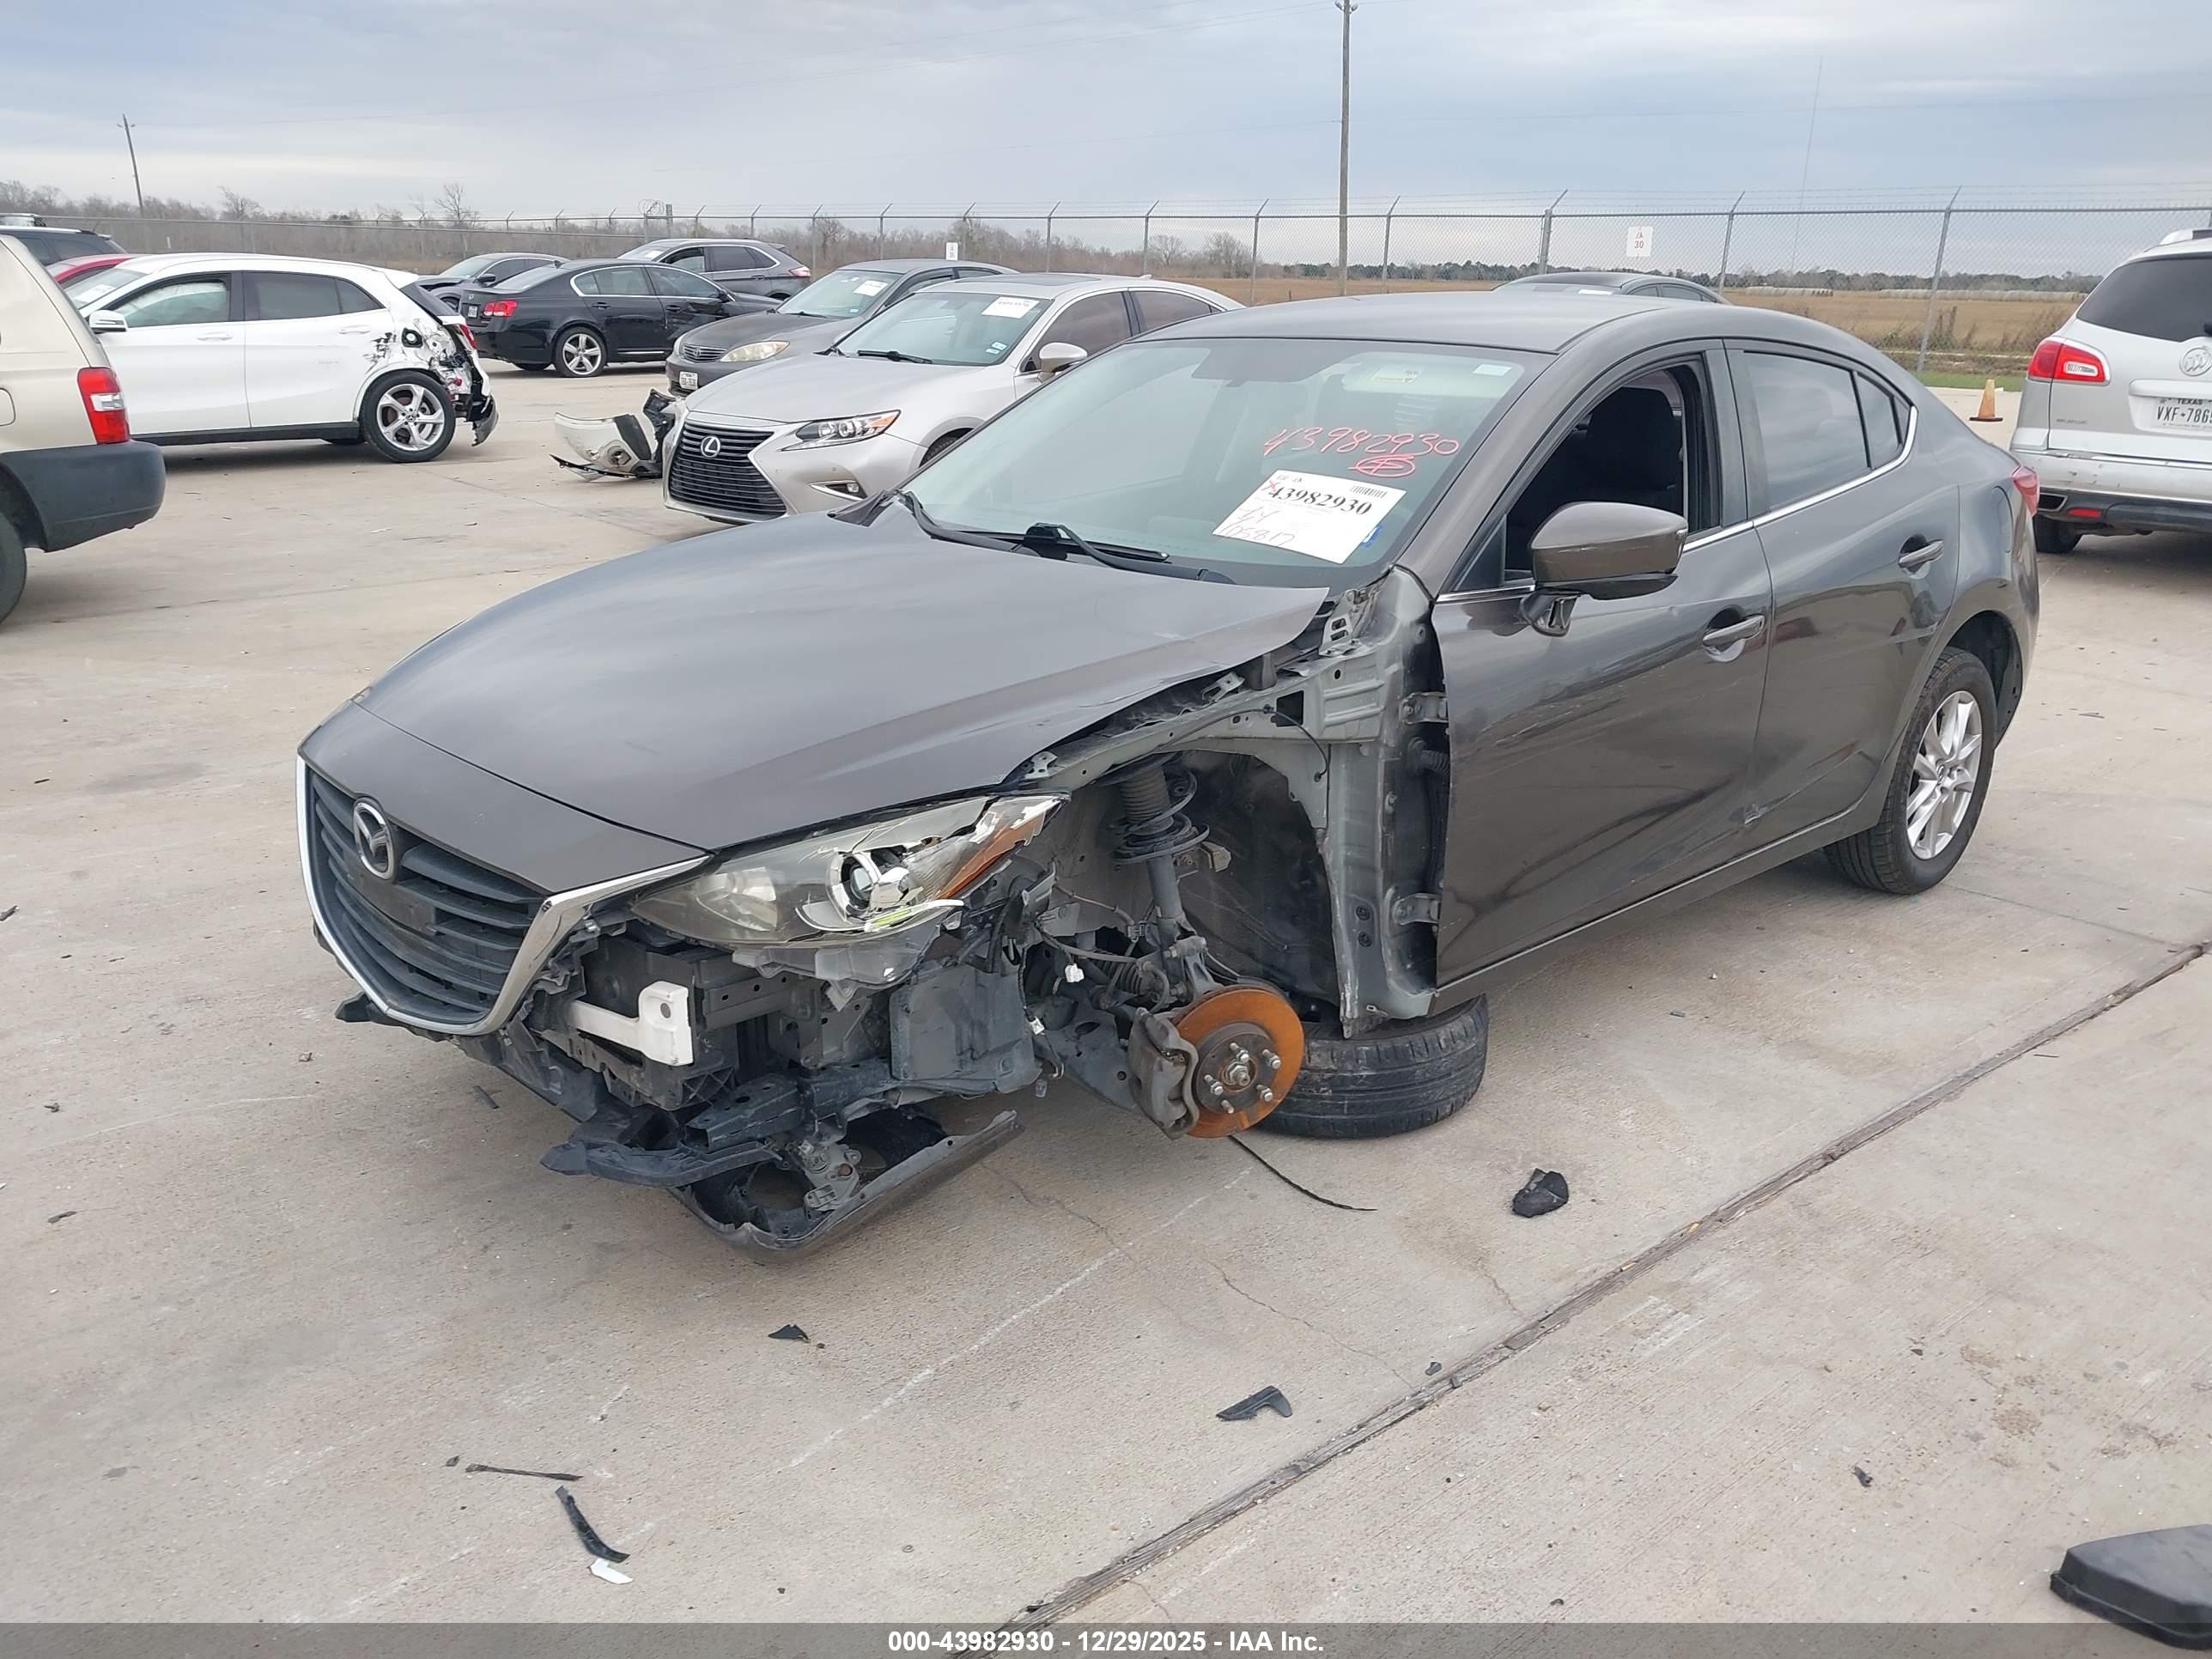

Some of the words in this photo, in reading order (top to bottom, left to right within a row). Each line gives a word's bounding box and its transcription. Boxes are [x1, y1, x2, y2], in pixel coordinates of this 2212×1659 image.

[1634, 240, 1644, 249] 30
[1264, 428, 1461, 457] 43982930
[1268, 487, 1372, 515] 43982930
